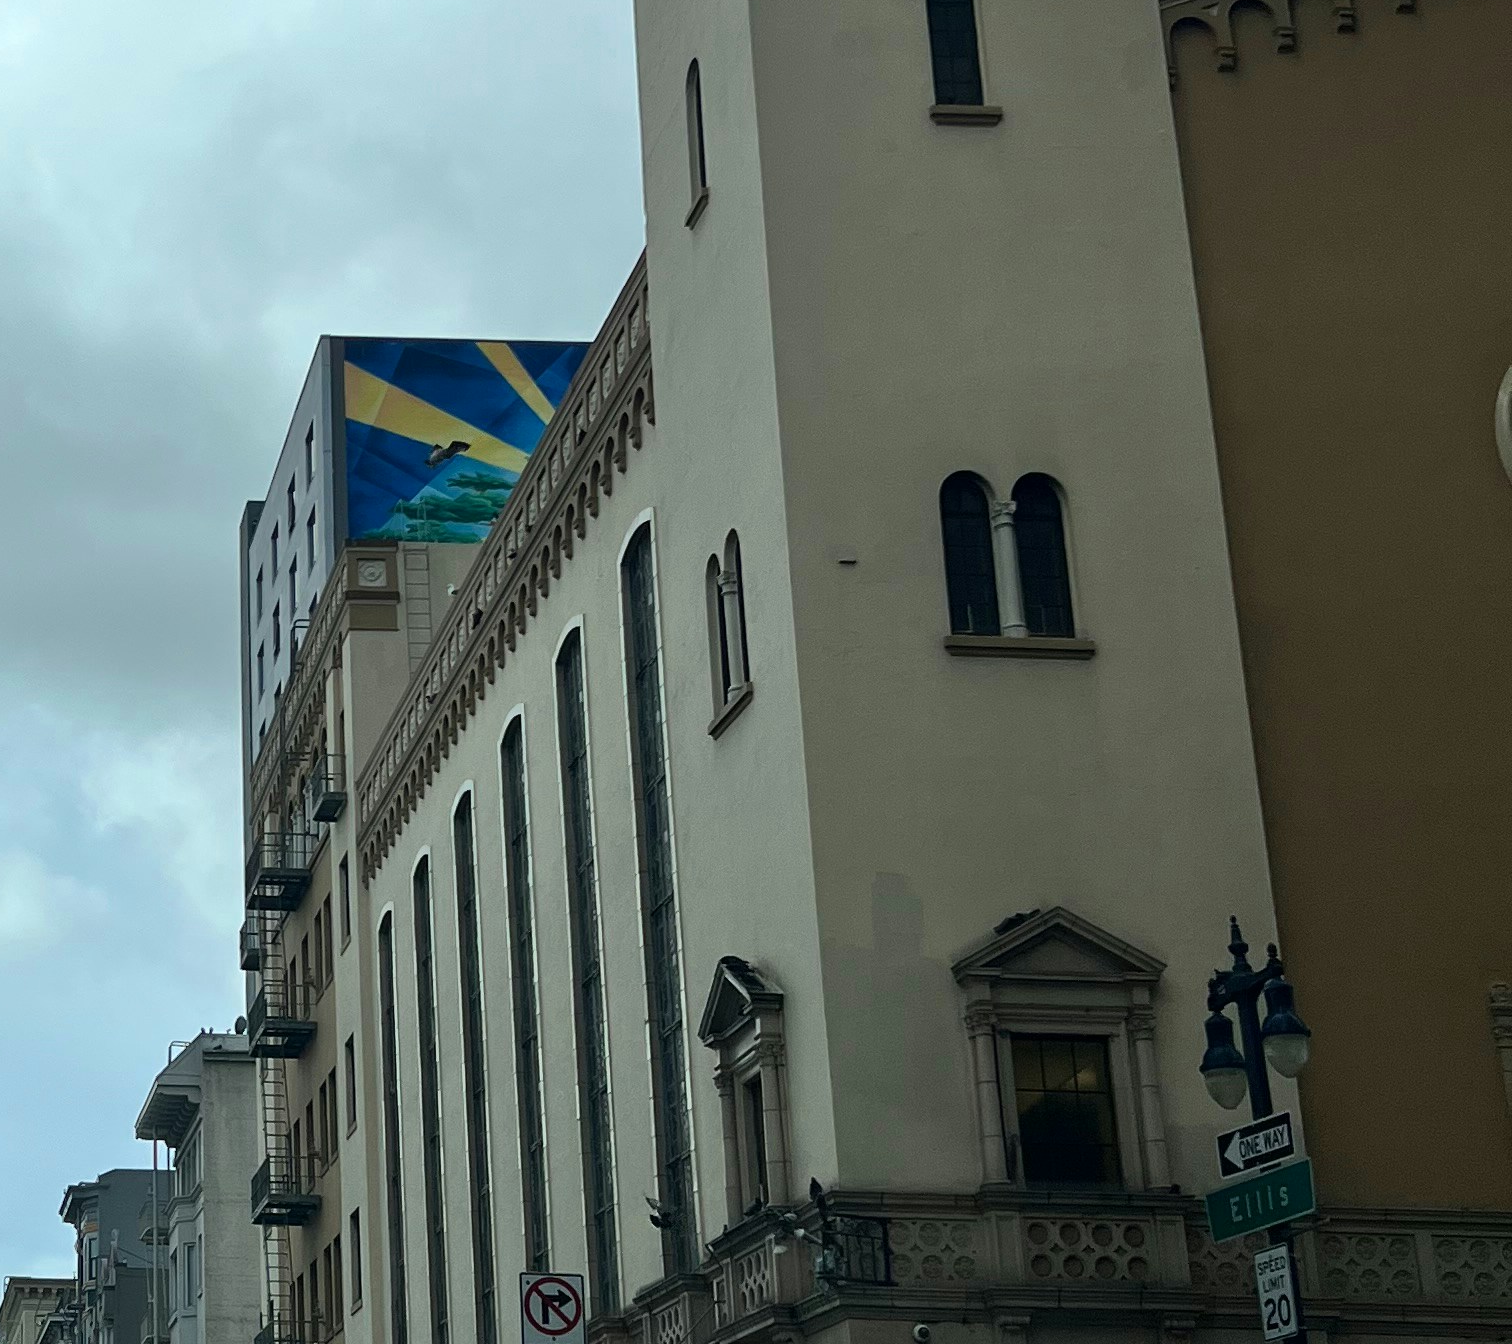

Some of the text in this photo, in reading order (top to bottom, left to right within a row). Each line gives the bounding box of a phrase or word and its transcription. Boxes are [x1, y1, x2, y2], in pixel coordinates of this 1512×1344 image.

[1238, 1126, 1287, 1158] ONE WAY
[1229, 1185, 1289, 1223] Ellis
[1257, 1256, 1286, 1276] SPEED
[1262, 1274, 1286, 1294] LIMIT
[1264, 1294, 1291, 1331] 20
